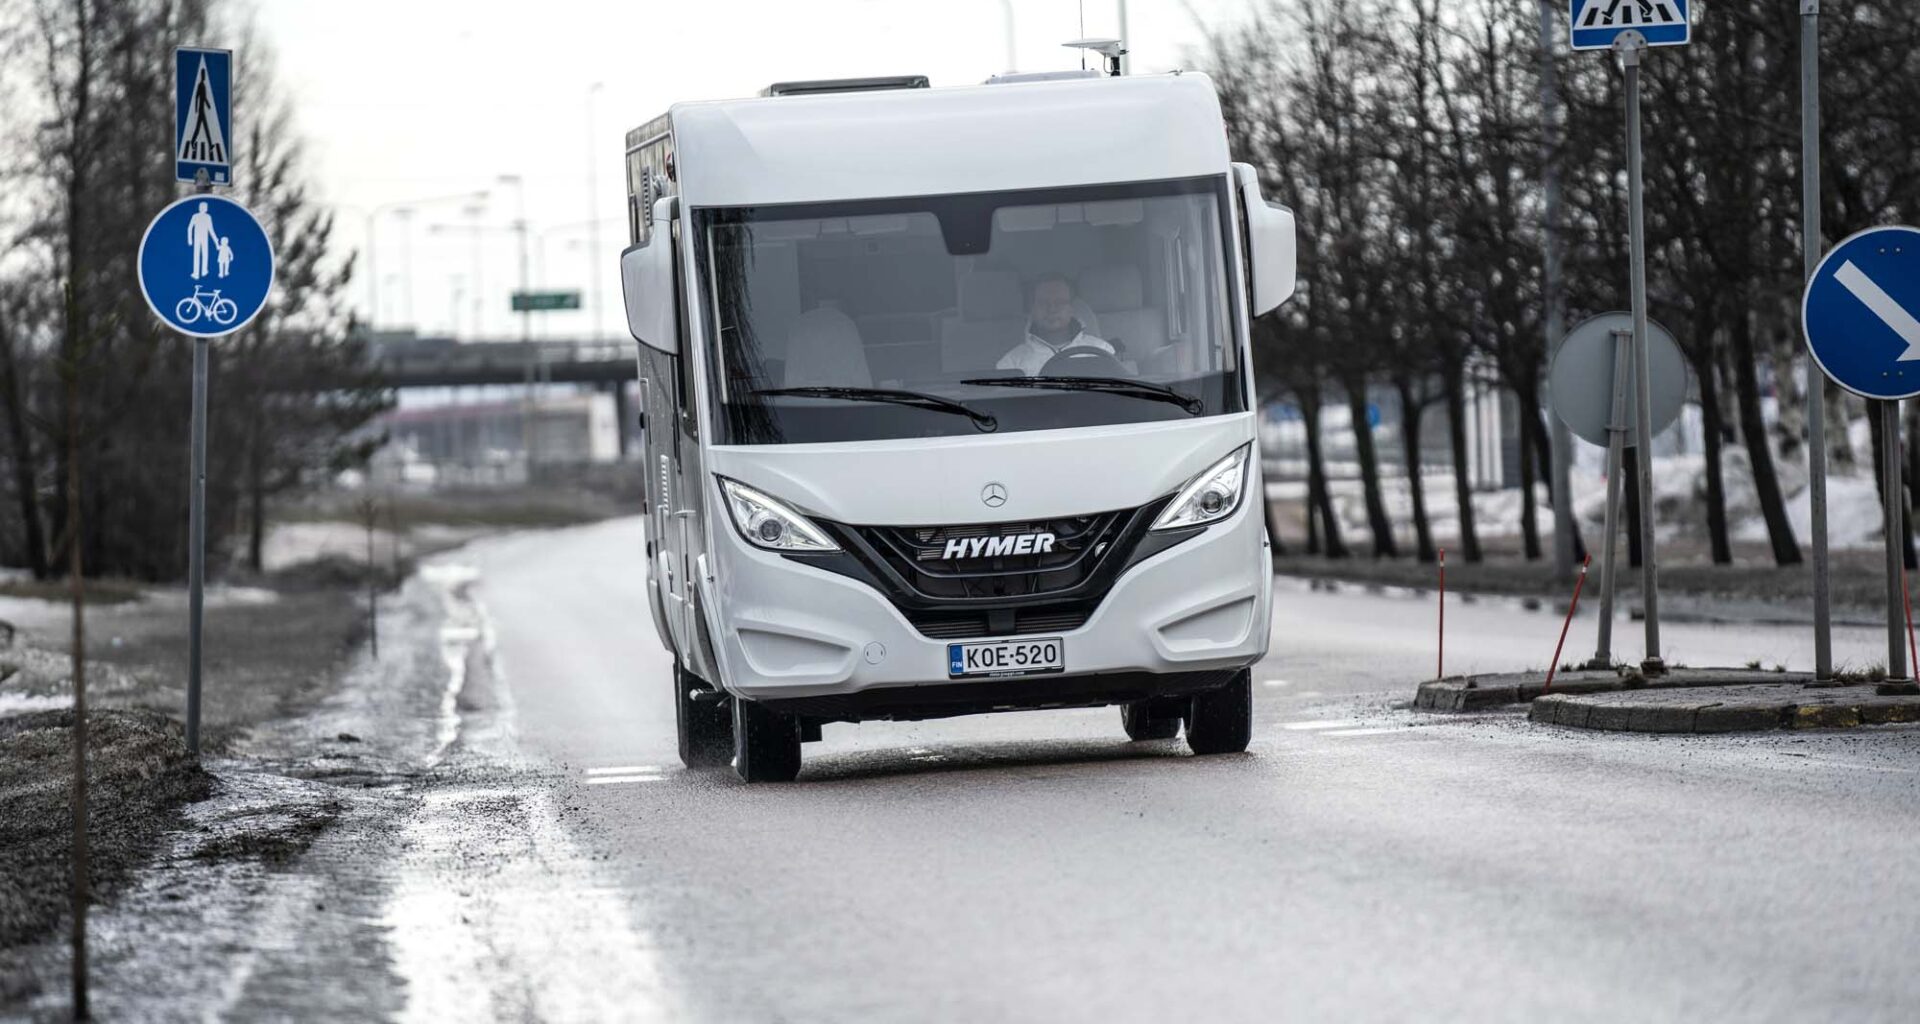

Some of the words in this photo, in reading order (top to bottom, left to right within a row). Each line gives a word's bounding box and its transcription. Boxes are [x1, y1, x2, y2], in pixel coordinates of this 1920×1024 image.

[942, 533, 1056, 560] HYMER
[951, 661, 963, 669] FIN
[966, 644, 1057, 668] KOE-520
